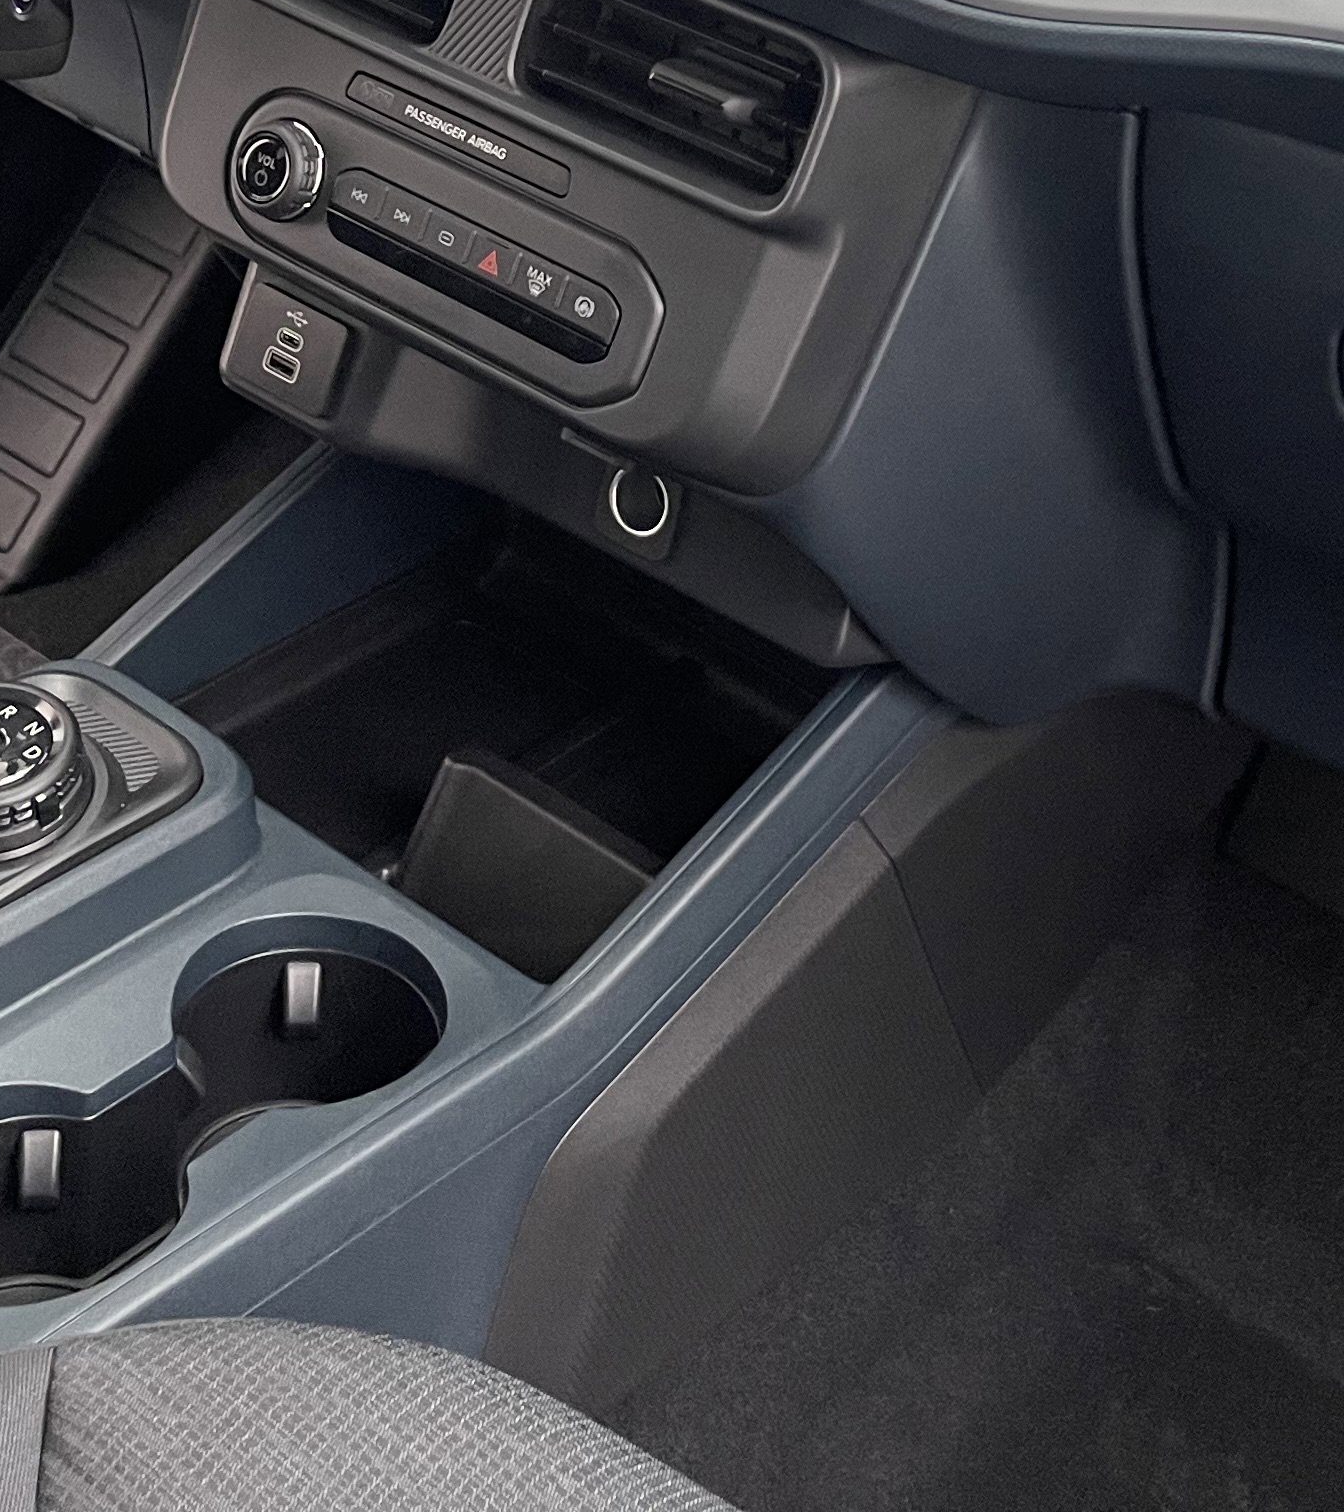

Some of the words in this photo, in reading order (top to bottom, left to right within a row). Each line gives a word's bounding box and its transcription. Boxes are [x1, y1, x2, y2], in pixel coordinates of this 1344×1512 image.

[405, 104, 466, 142] PASSENGER
[467, 134, 507, 160] AIRBAG
[258, 151, 276, 170] VOL
[526, 265, 553, 287] MAX
[0, 705, 18, 719] R
[23, 721, 45, 736] N
[22, 745, 42, 760] D
